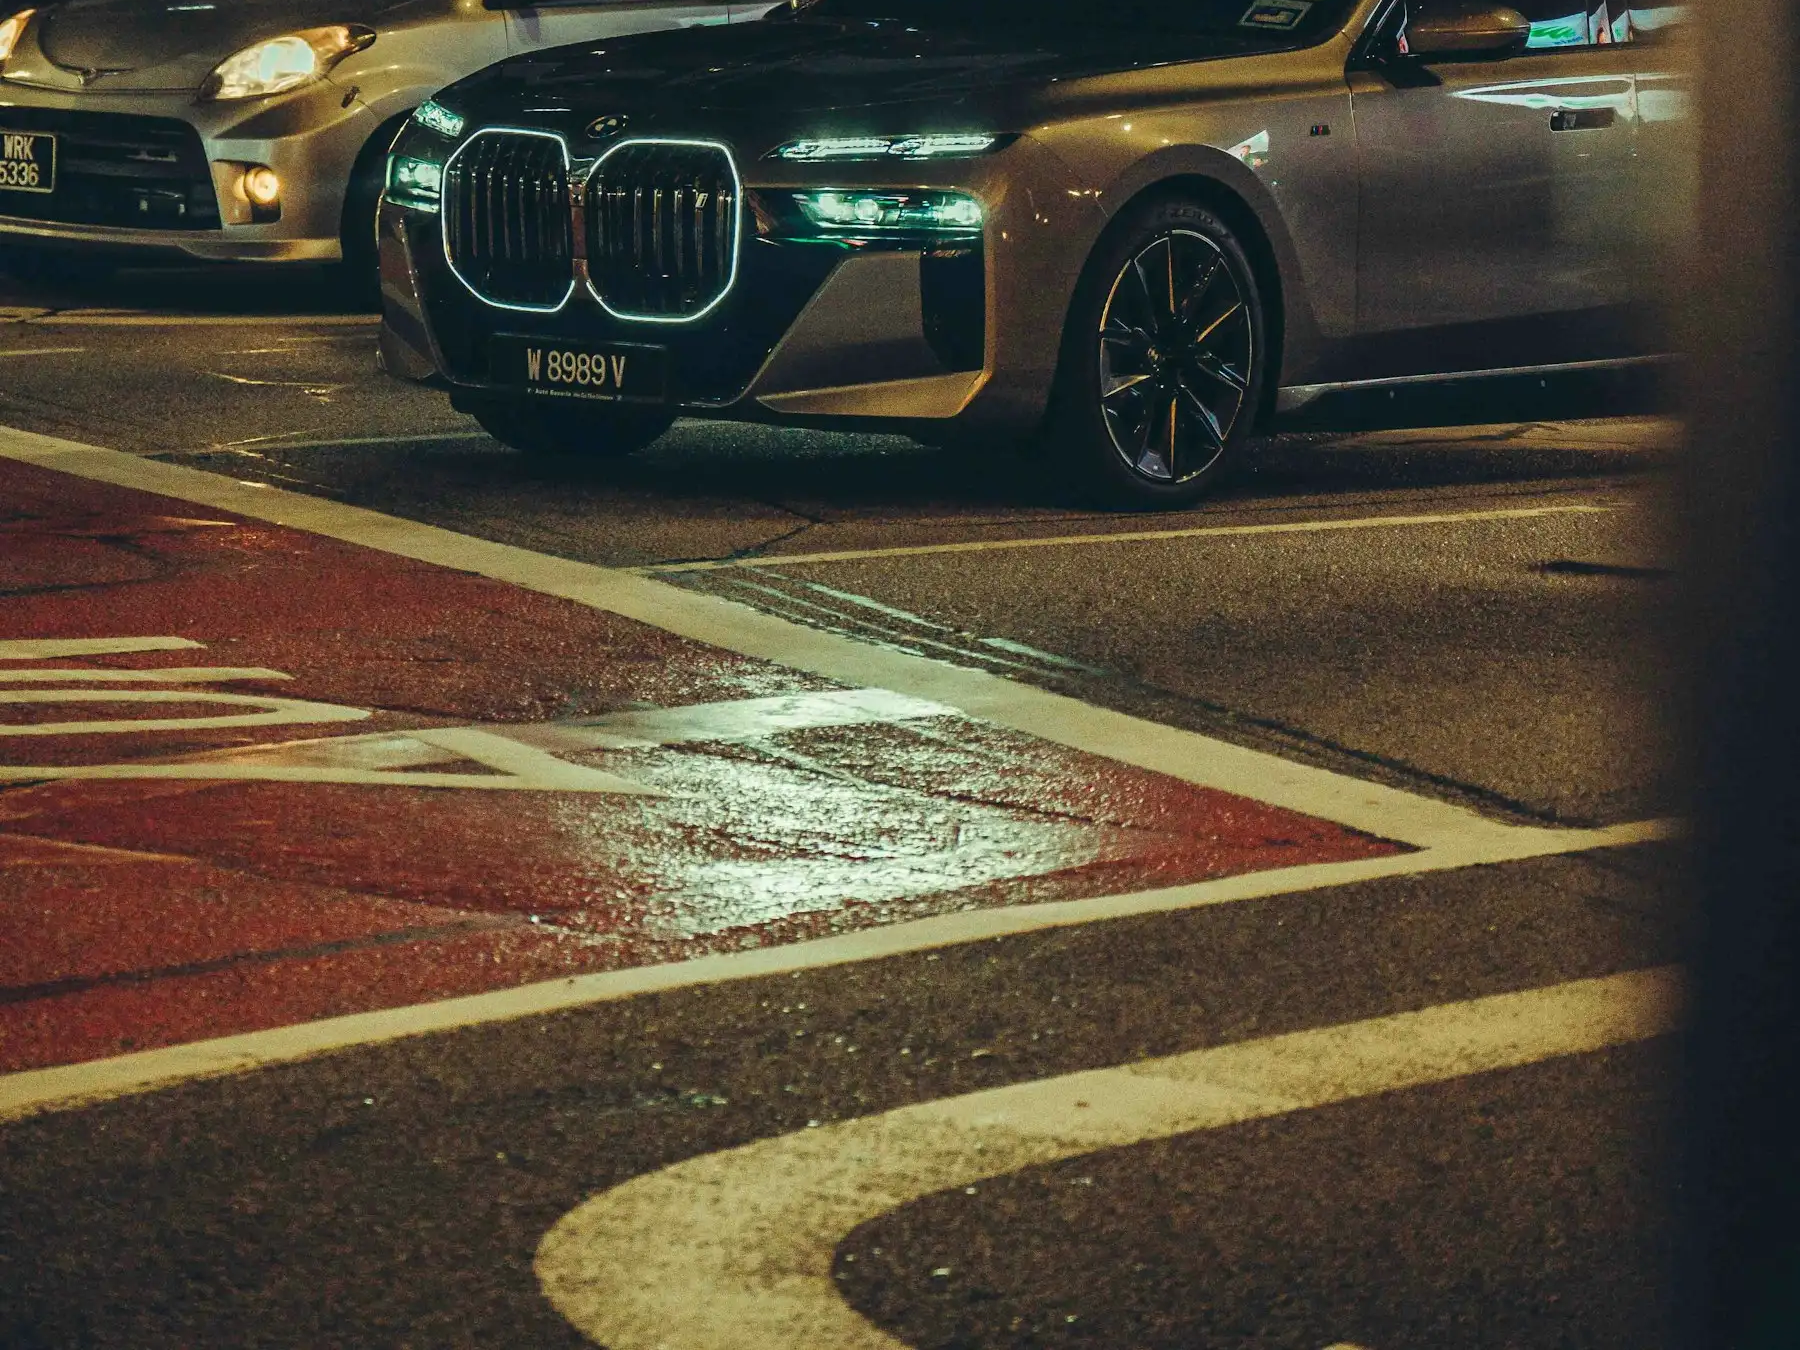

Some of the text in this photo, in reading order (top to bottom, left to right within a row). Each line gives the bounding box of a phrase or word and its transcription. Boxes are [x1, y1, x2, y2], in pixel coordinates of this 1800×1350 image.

[4, 134, 35, 160] WRK
[0, 160, 40, 186] 5336
[527, 348, 626, 388] W 8989 V
